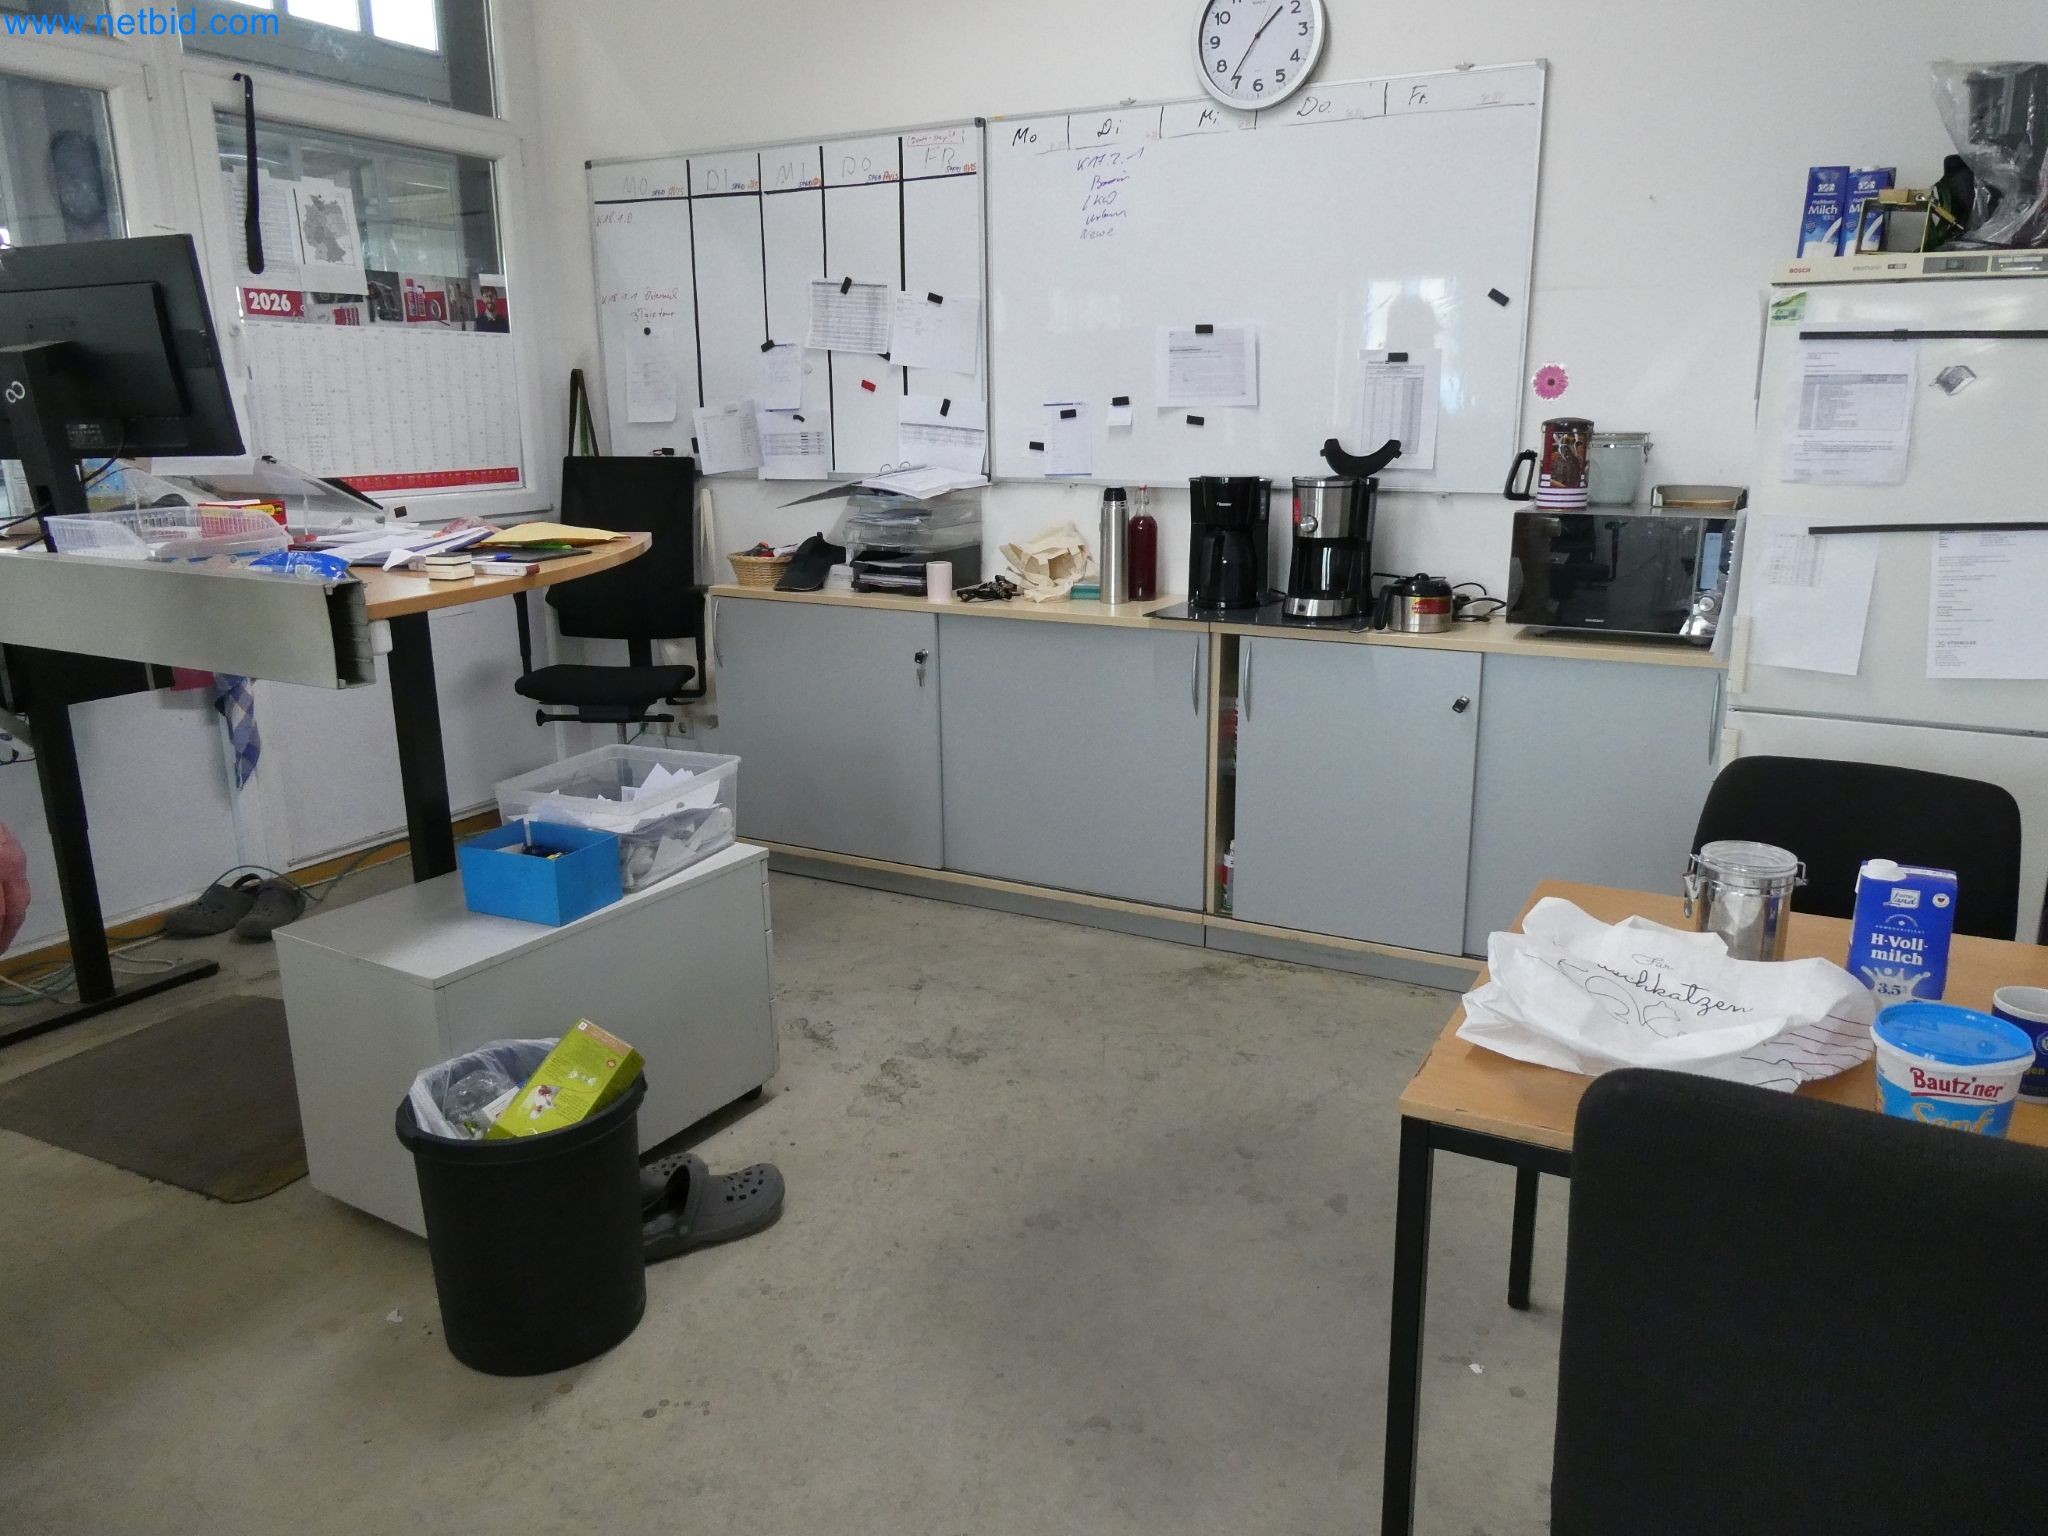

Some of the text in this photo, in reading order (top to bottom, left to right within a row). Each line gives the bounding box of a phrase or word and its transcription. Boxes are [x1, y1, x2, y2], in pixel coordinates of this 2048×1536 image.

[1290, 0, 1302, 14] 2
[1214, 11, 1231, 26] 10
[1298, 21, 1308, 36] 3
[1210, 36, 1220, 49] 9
[1290, 48, 1300, 62] 4
[1216, 59, 1227, 73] 8
[1231, 75, 1242, 90] 7
[1275, 68, 1286, 83] 5
[1252, 78, 1263, 92] 6
[1199, 108, 1220, 127] Mi
[1097, 119, 1122, 137] Di
[1012, 127, 1038, 147] Mo
[706, 168, 728, 192] DI
[1808, 204, 1838, 215] Milch
[249, 292, 292, 312] 2026
[1871, 932, 1929, 951] H-Voll-
[1871, 949, 1924, 966] milch
[1910, 1066, 2003, 1098] Bautz'ner
